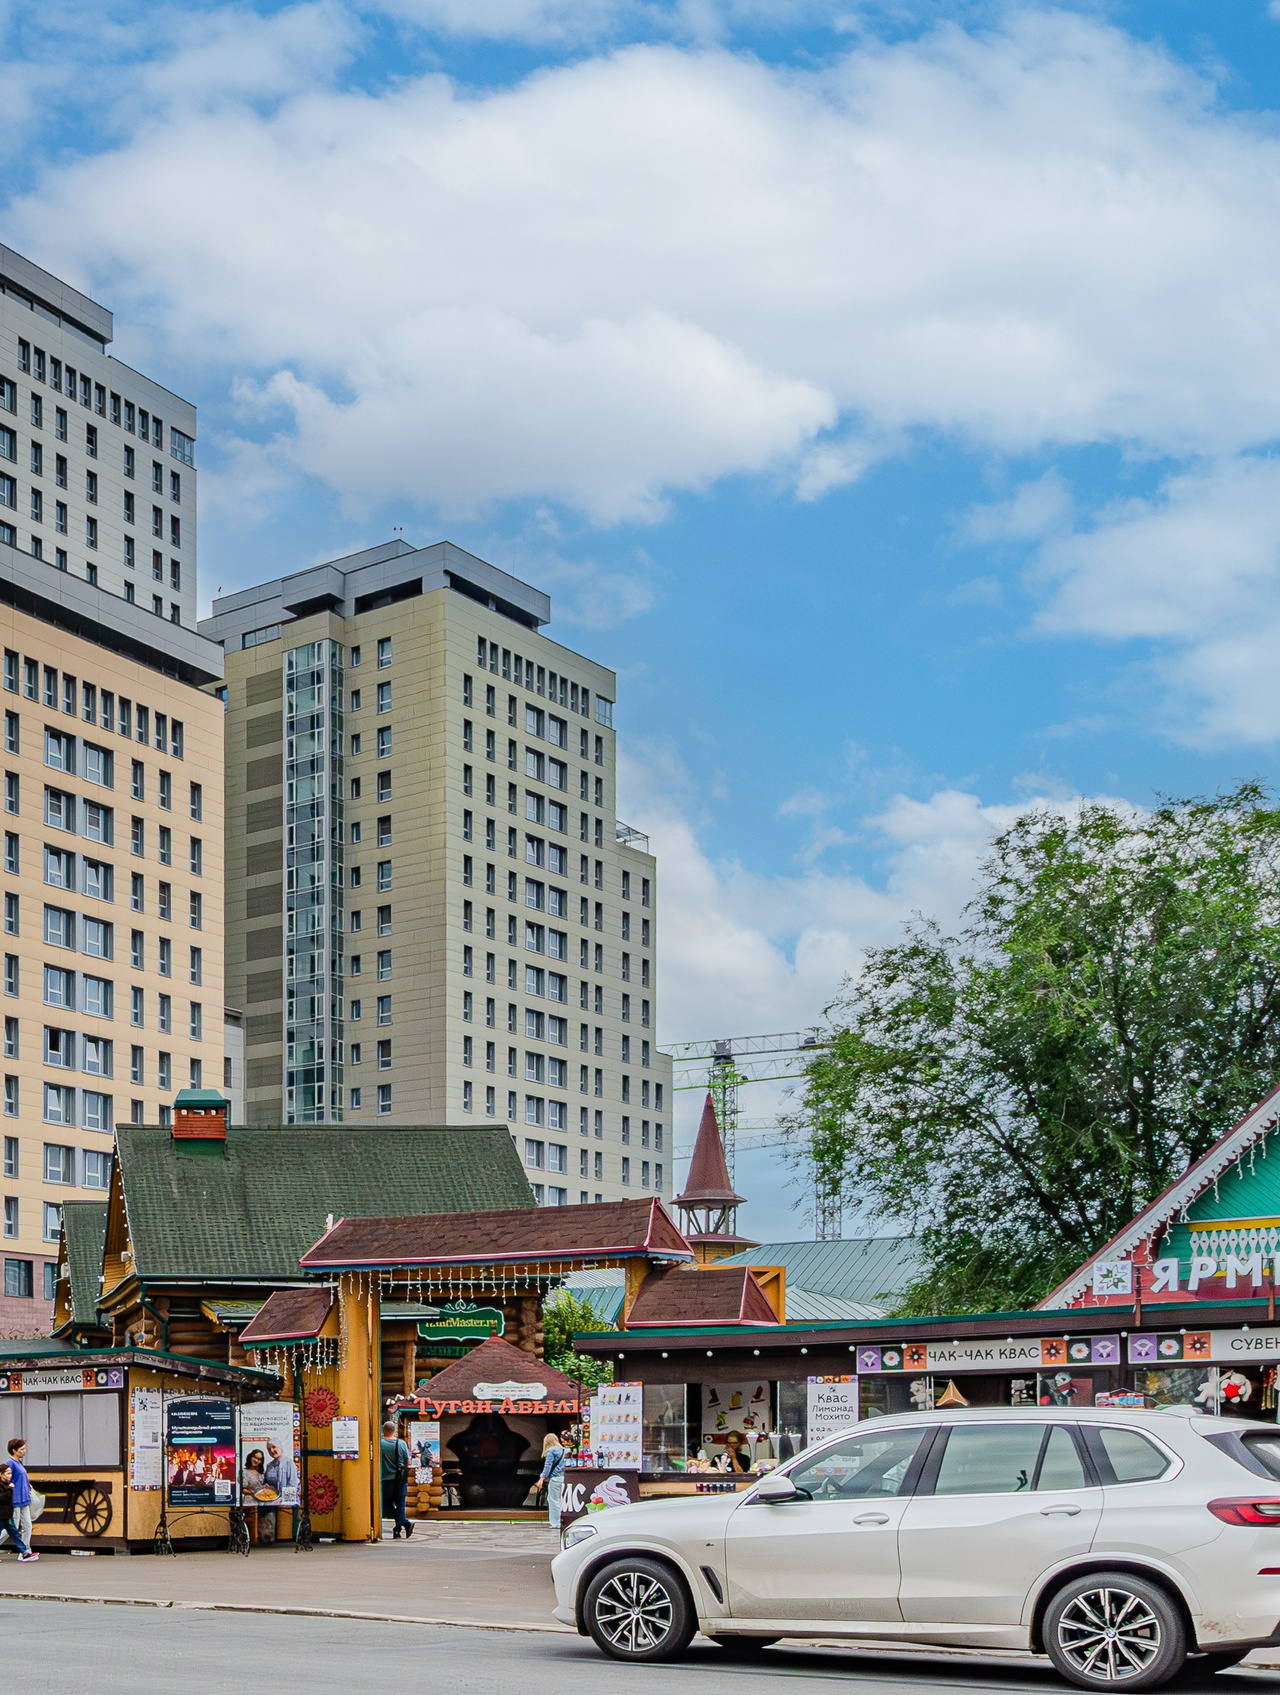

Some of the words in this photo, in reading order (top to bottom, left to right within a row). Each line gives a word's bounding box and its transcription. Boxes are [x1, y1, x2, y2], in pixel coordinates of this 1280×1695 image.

[928, 1348, 994, 1362] ЧАК-ЧАК
[999, 1346, 1040, 1359] КВАС
[22, 1375, 59, 1386] ЧАК-ЧАК
[59, 1374, 82, 1384] КВАС
[817, 1393, 849, 1404] Квас
[414, 1397, 492, 1419] Туган
[815, 1413, 851, 1421] Мохито
